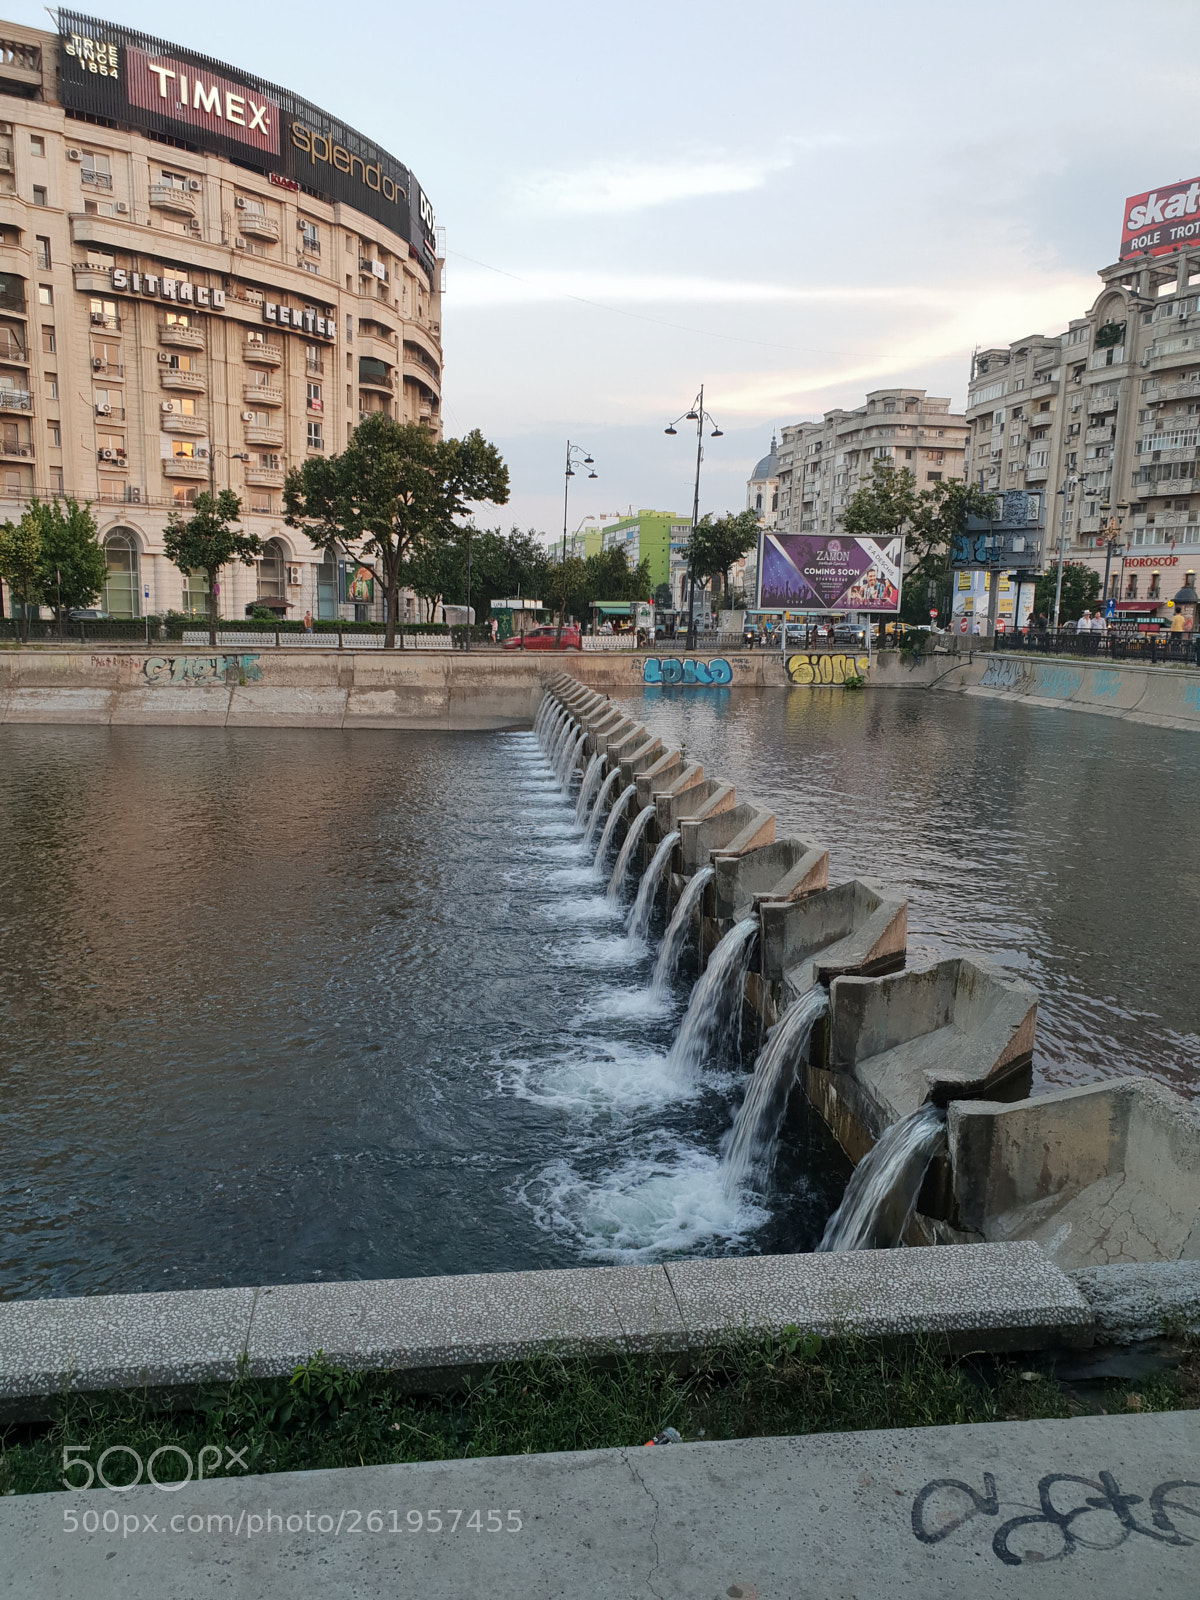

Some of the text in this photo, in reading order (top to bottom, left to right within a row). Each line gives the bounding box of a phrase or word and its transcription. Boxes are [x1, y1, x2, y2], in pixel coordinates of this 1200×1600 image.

[65, 44, 118, 68] SINCE
[71, 33, 118, 57] TRUE
[80, 59, 119, 79] 1854
[149, 64, 269, 135] TIMEX
[1127, 181, 1200, 231] skat
[1131, 231, 1161, 250] ROLE
[111, 268, 336, 338] SITRACO CENTER
[816, 550, 850, 561] ZAMON
[1124, 556, 1179, 568] HOROSCOP
[804, 567, 860, 576] COMING SOON
